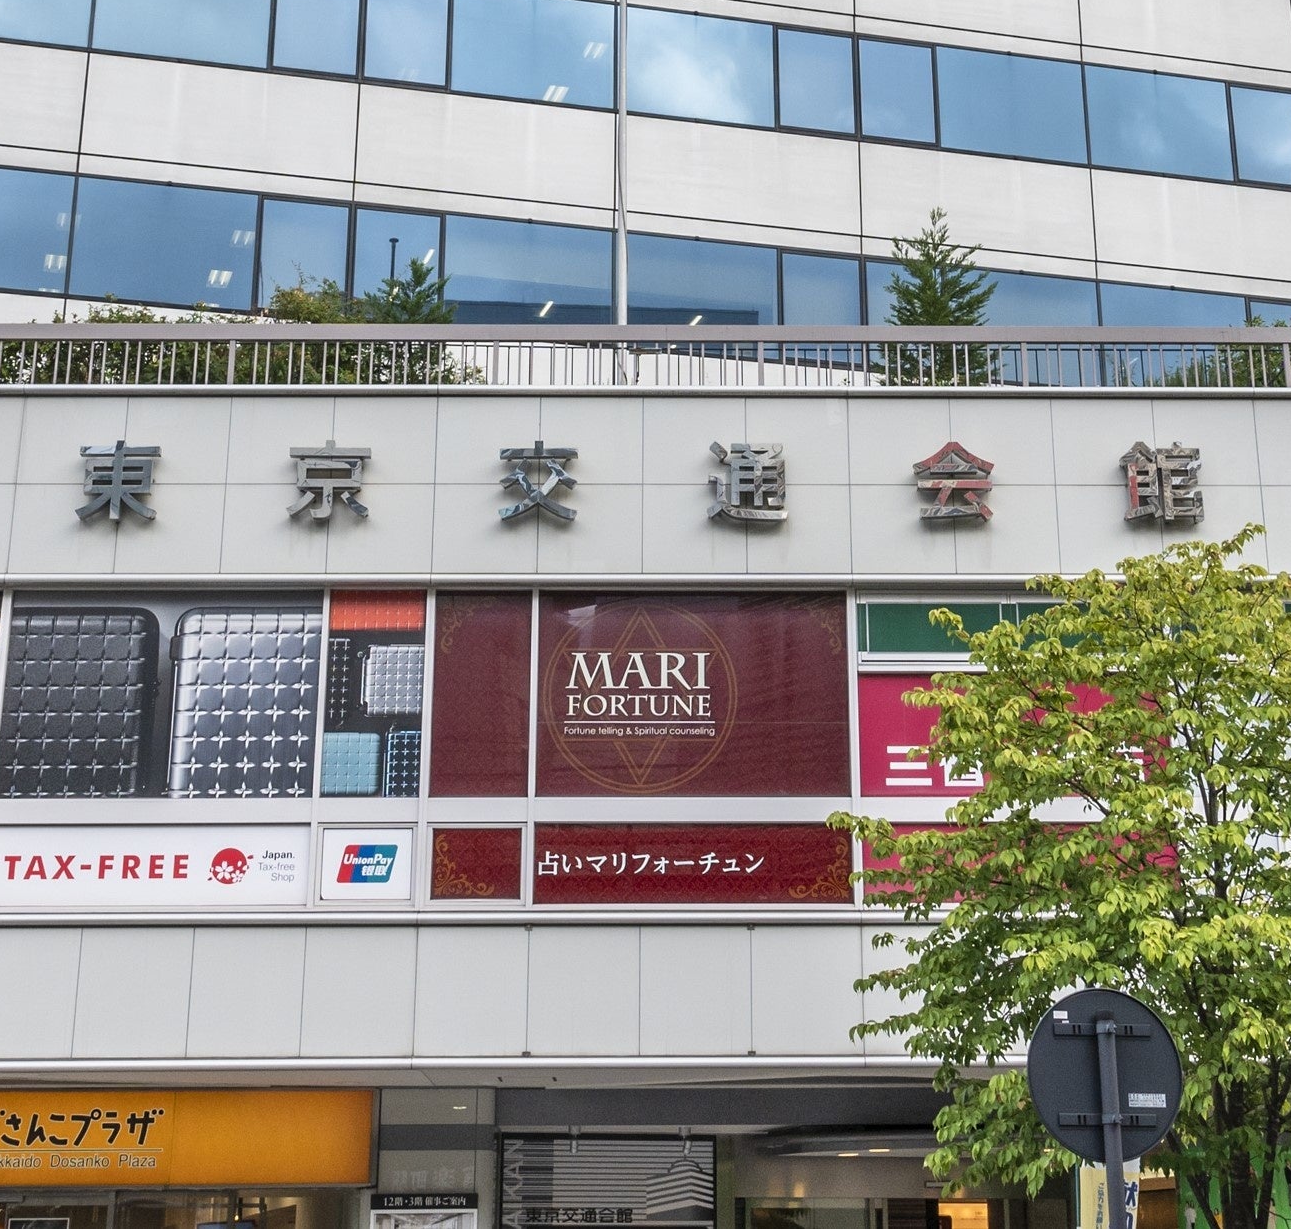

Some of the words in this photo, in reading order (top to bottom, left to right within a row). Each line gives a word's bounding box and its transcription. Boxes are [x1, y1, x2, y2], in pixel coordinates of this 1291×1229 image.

[75, 440, 1205, 523] 東京交通会館
[565, 652, 710, 690] MARI
[566, 694, 711, 717] FORTUNE
[564, 727, 596, 735] Fortune
[598, 726, 624, 736] telling
[626, 727, 632, 735] &
[634, 726, 667, 737] Spiritual
[669, 726, 716, 737] counseling
[4, 855, 189, 880] TAX-FREE
[258, 862, 295, 871] Tax-free
[343, 853, 394, 867] UnionPay
[538, 851, 765, 876] 占いマリフォーチュン
[270, 872, 295, 882] Shop
[49, 1154, 110, 1168] Dosanko
[117, 1154, 156, 1168] Plaza
[525, 1207, 634, 1224] 東京交通会館
